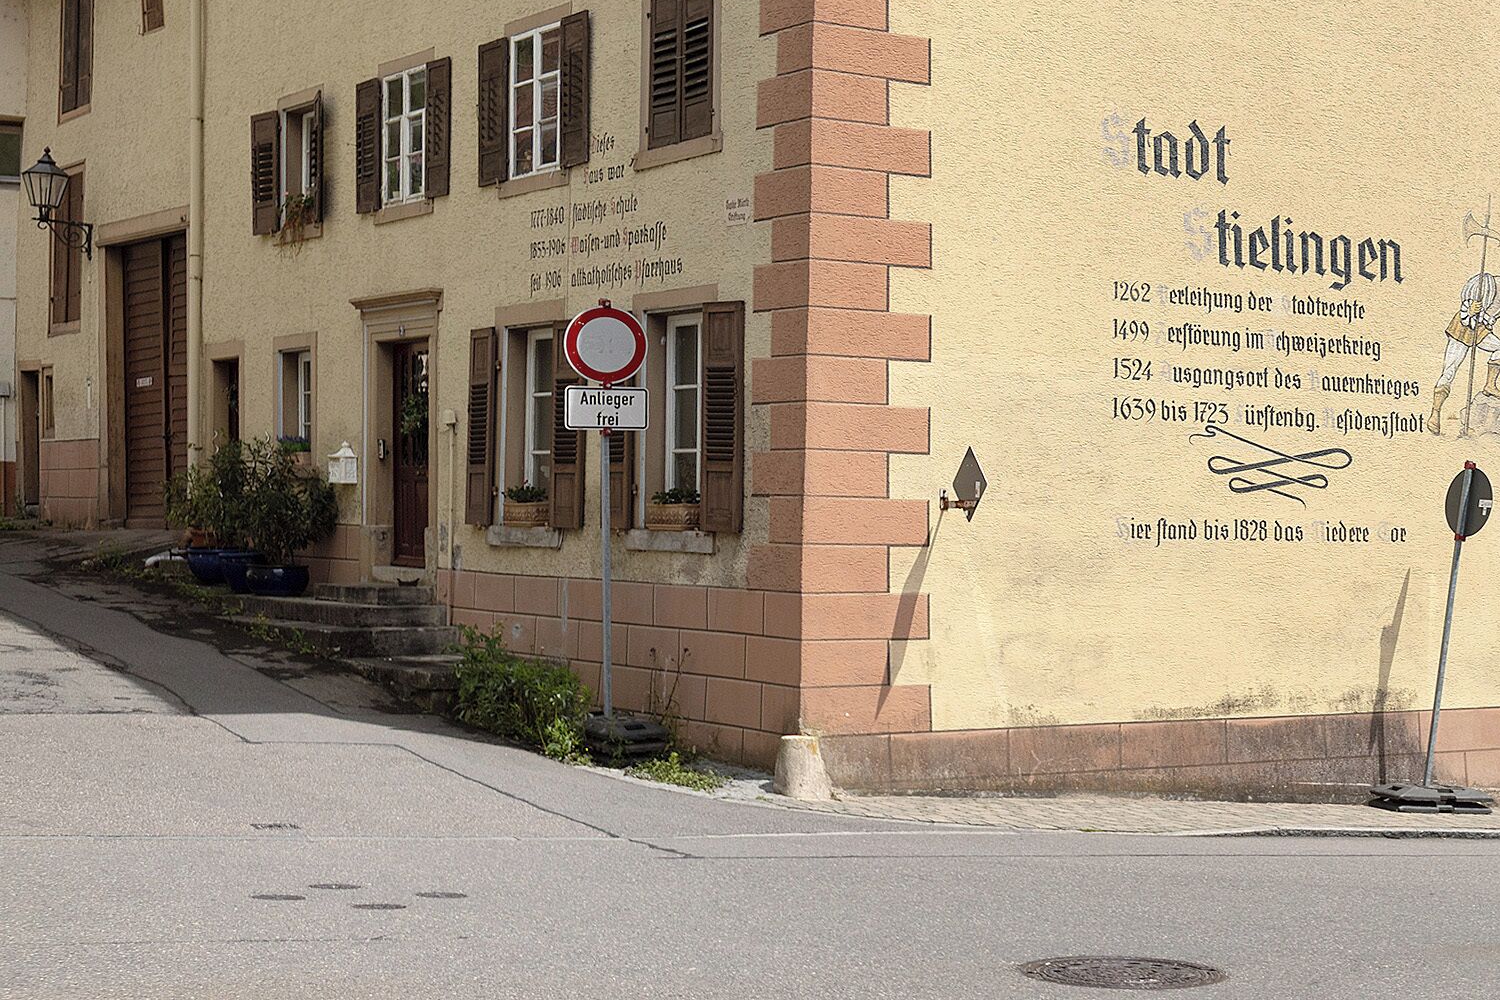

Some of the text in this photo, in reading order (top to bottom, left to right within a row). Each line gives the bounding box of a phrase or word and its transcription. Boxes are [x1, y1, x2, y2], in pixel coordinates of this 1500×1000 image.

[1101, 112, 1231, 186] Stadt
[608, 164, 625, 181] war
[1113, 281, 1151, 303] 1262
[1248, 291, 1273, 312] der
[1112, 318, 1381, 362] 1499 erstörung im chweizerkrieg
[1112, 357, 1153, 381] 1524
[1274, 367, 1301, 389] des
[580, 391, 635, 409] Anlieger
[1112, 396, 1156, 423] 1639
[1161, 400, 1187, 422] bis
[1193, 401, 1229, 424] 1723
[596, 412, 619, 426] frei
[1204, 519, 1229, 540] bis
[1233, 518, 1268, 541] 1828
[1274, 520, 1303, 542] das
